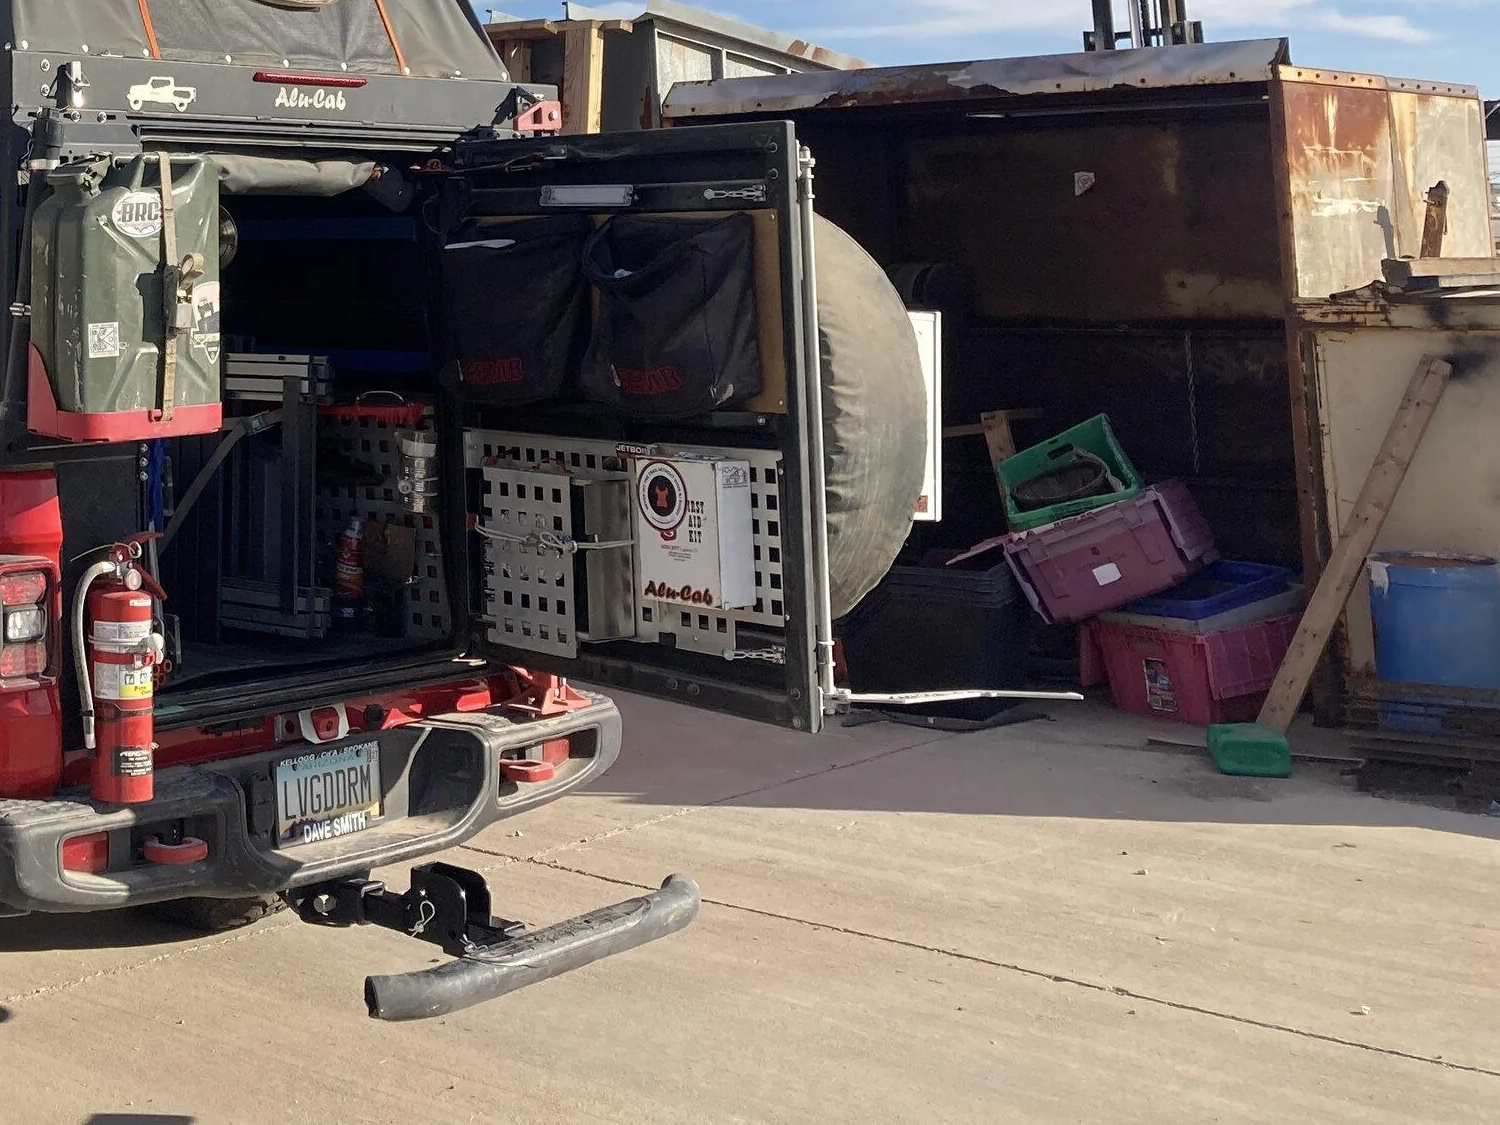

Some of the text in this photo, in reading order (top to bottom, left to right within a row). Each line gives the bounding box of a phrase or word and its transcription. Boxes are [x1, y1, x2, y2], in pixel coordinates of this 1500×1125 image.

[274, 86, 347, 111] Alu-Cab
[121, 201, 159, 222] BRC
[687, 499, 705, 514] IRST
[688, 515, 702, 529] AID
[688, 529, 702, 544] KIT
[644, 580, 713, 606] Alu-Cab
[280, 753, 316, 767] KELLOGG
[344, 740, 379, 754] SPOKANE
[284, 763, 372, 821] LVGDDRM
[304, 810, 367, 844] DAVE SMITH
